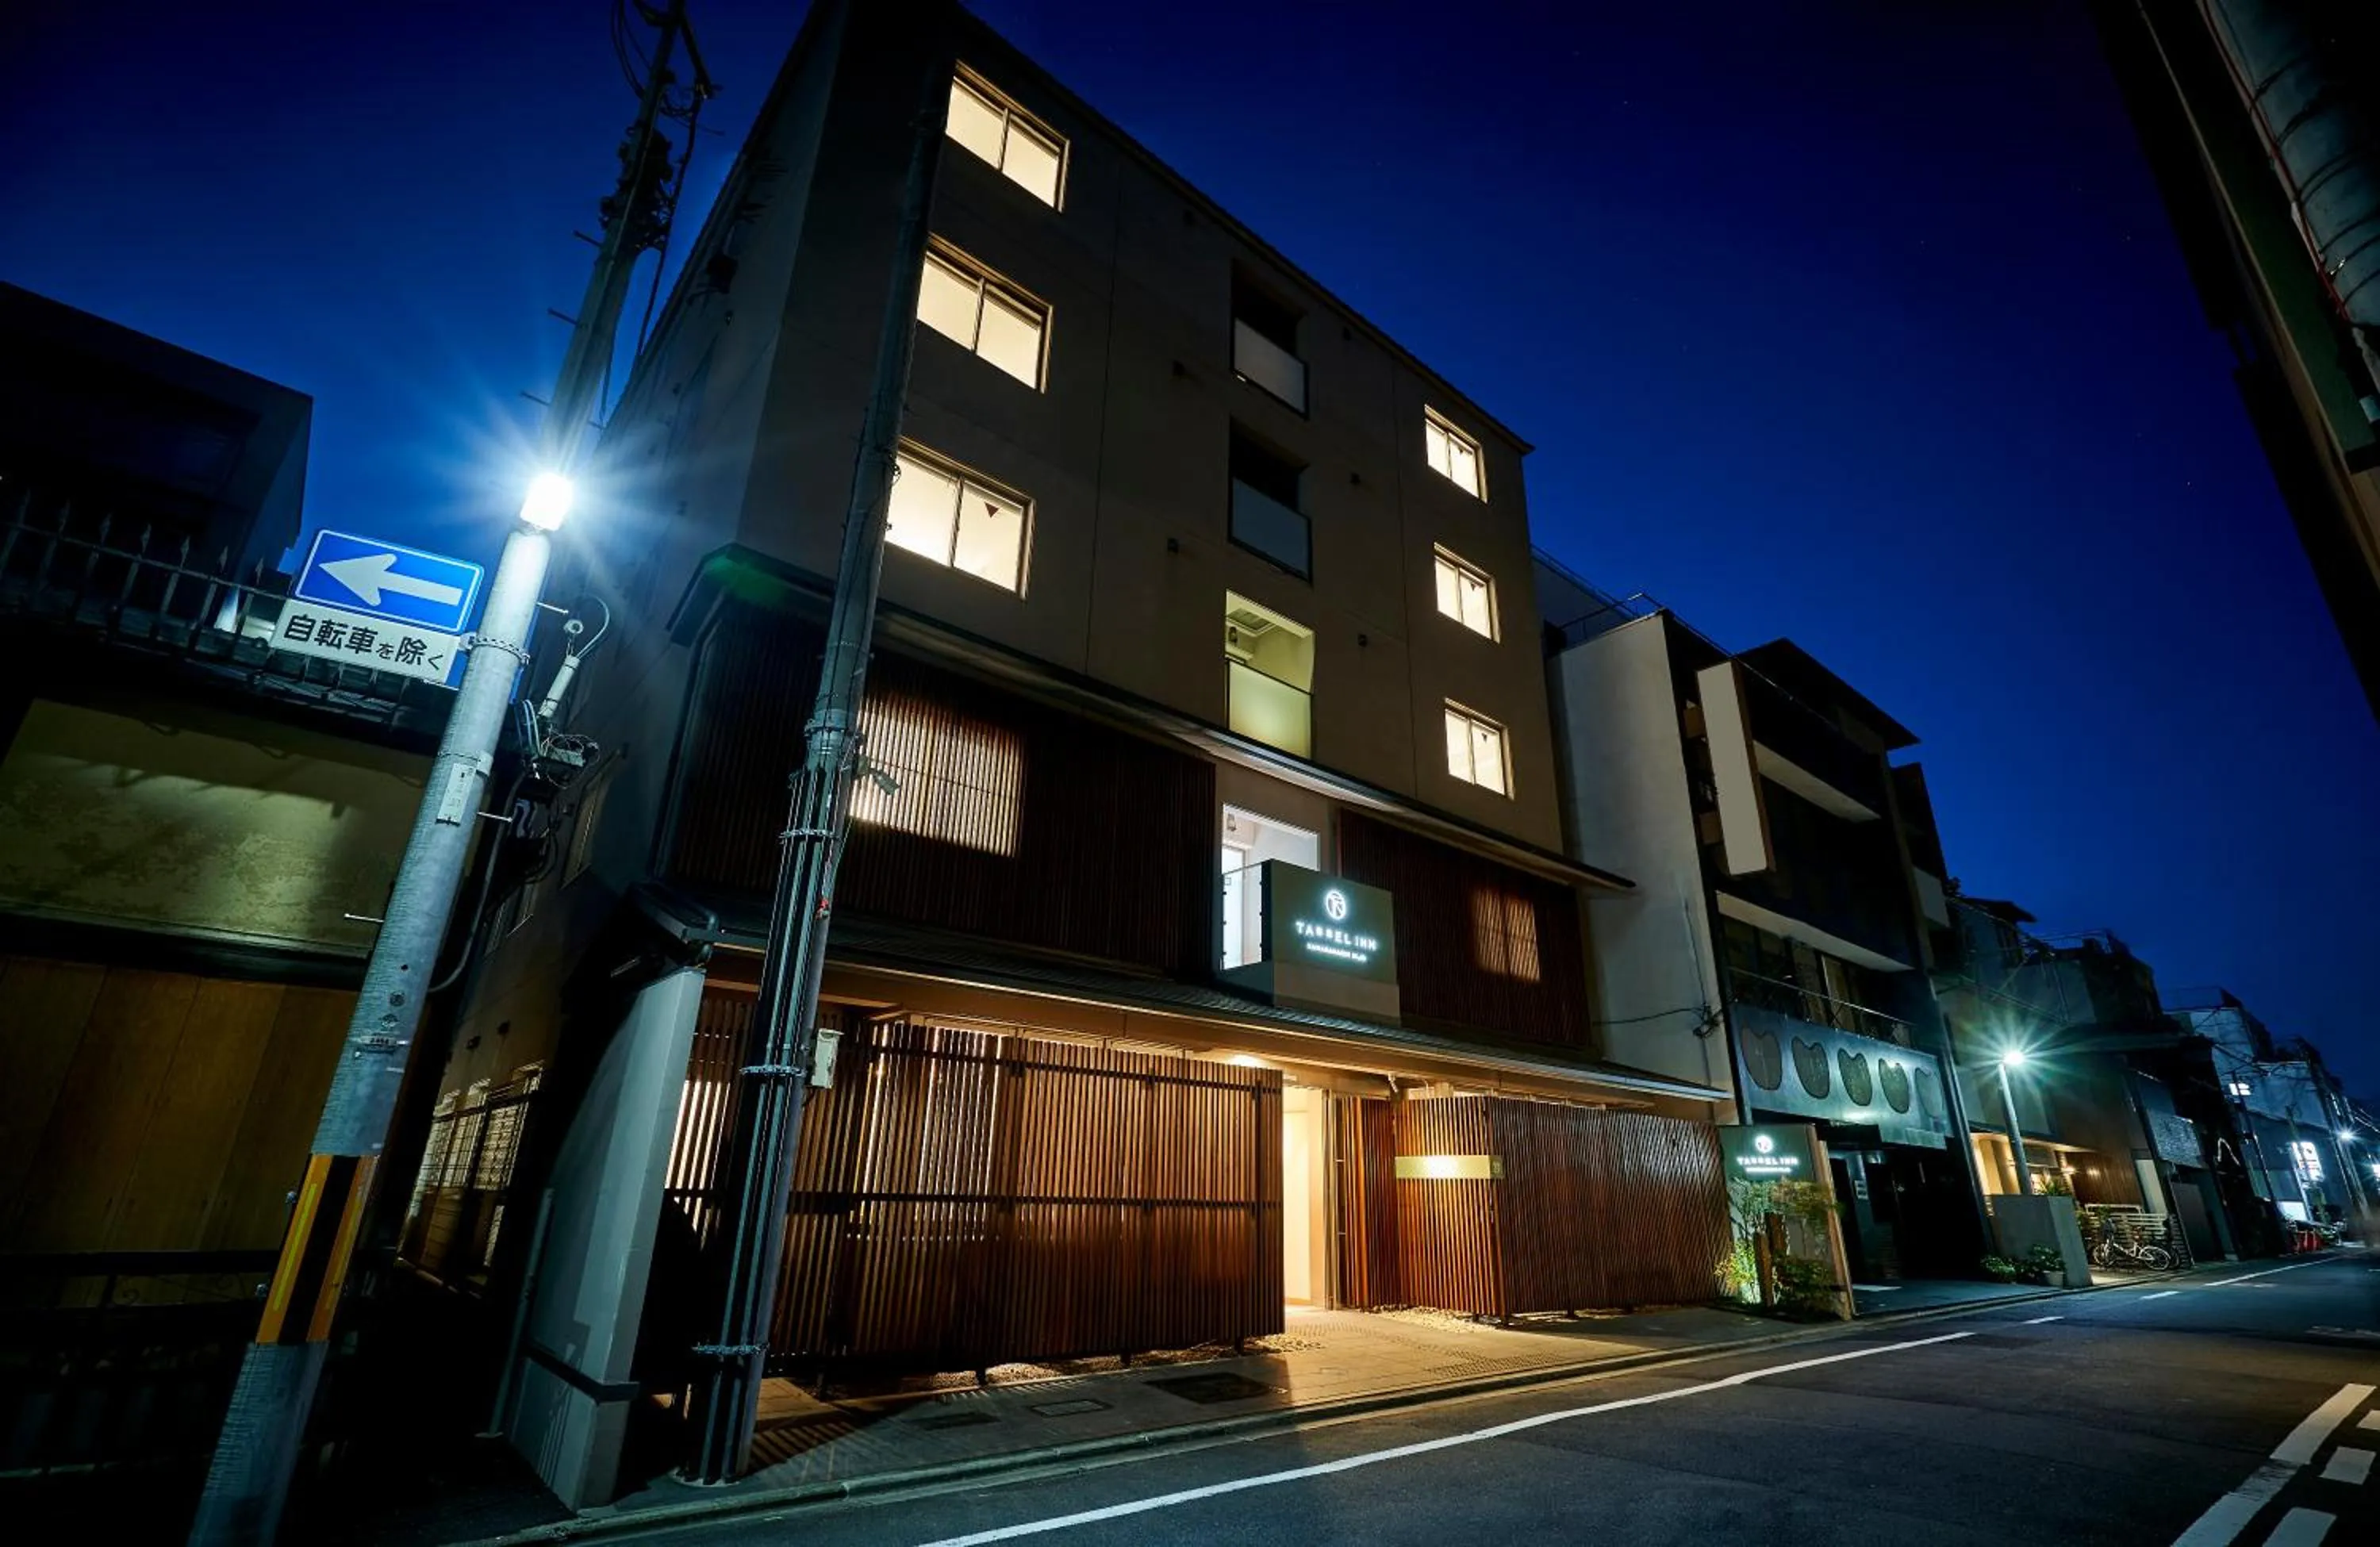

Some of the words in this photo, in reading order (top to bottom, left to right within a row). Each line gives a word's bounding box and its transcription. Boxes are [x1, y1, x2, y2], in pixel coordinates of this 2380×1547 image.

[283, 613, 444, 671] 自転車を除く
